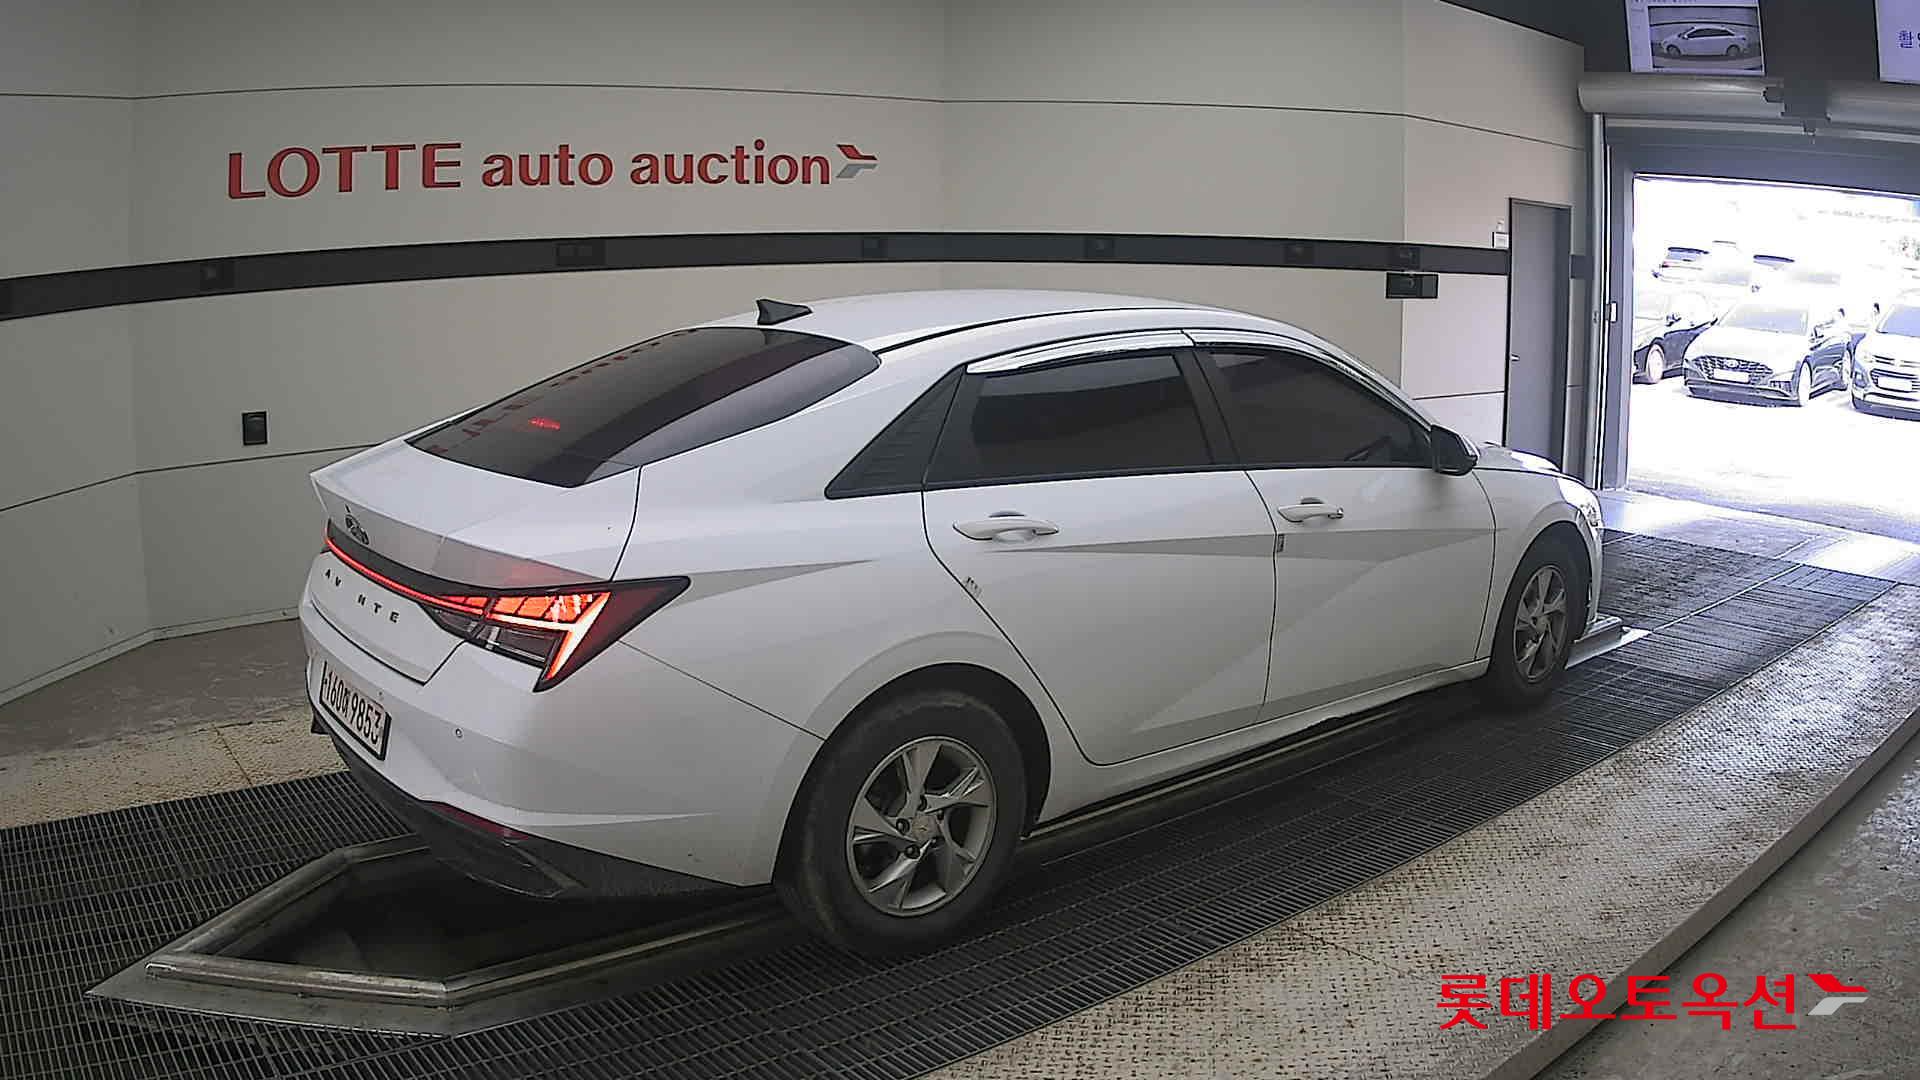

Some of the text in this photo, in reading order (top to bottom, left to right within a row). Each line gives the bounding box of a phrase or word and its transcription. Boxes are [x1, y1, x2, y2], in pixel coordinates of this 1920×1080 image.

[228, 139, 830, 199] LOTTE auto auction
